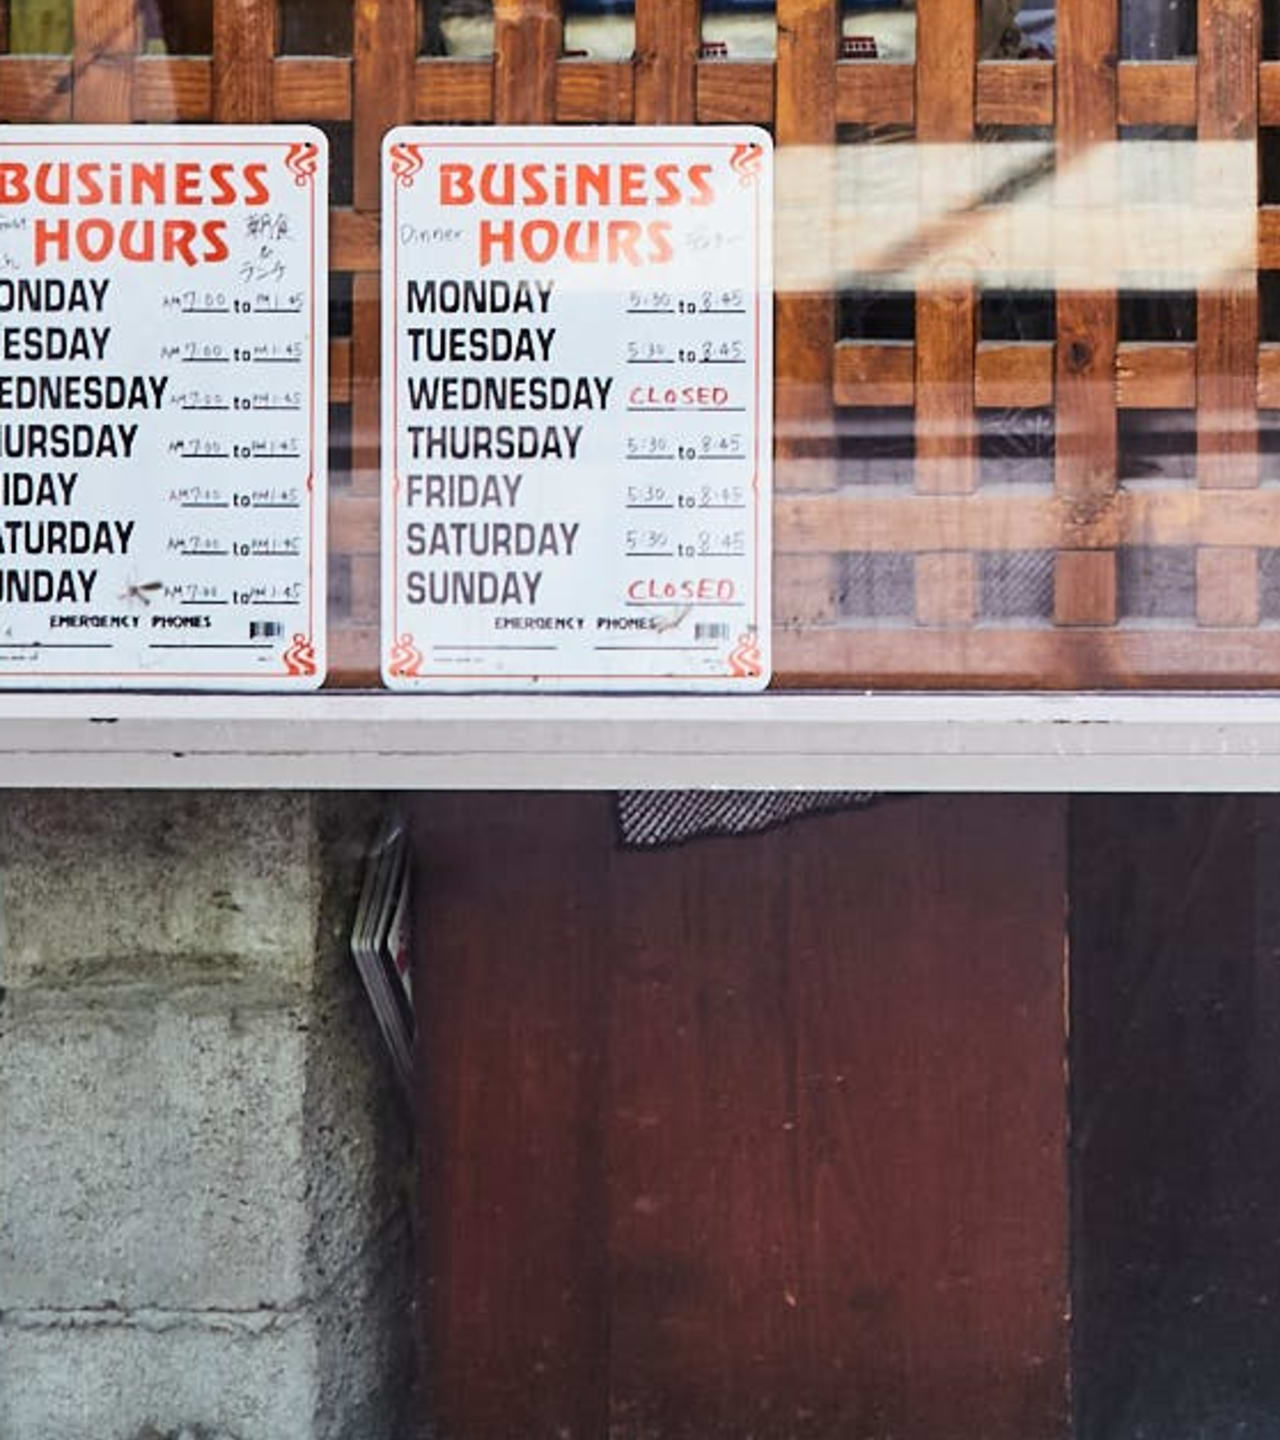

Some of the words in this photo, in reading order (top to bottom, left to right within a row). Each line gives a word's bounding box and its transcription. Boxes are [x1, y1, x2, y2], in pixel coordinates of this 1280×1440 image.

[34, 218, 230, 267] HOURS
[400, 224, 465, 246] Dinner
[479, 219, 674, 267] HOURS
[233, 300, 251, 313] to
[407, 280, 554, 313] MONDAY
[679, 300, 696, 313] to
[233, 349, 251, 362] to
[407, 328, 556, 361] TUESDAY
[679, 350, 696, 363] to
[233, 397, 251, 410] to
[408, 377, 614, 410] WEDNESDAY
[629, 387, 729, 405] CLOSED
[0, 424, 138, 458] URSDAY
[233, 445, 251, 458] to
[408, 426, 583, 459] THURSDAY
[678, 446, 696, 459] to
[233, 493, 251, 507] to
[407, 474, 523, 507] FRIDAY
[678, 495, 696, 508] to
[233, 542, 250, 556] to
[407, 523, 580, 556] SATURDAY
[678, 544, 695, 557] to
[0, 569, 97, 603] NDAY
[233, 591, 250, 604] to
[407, 571, 543, 604] SUNDAY
[627, 577, 735, 600] CLOSED
[50, 615, 140, 628] EMERGENCY
[152, 615, 211, 628] PHONES
[495, 617, 584, 630] EMERGENCY
[597, 617, 657, 630] PHONES
